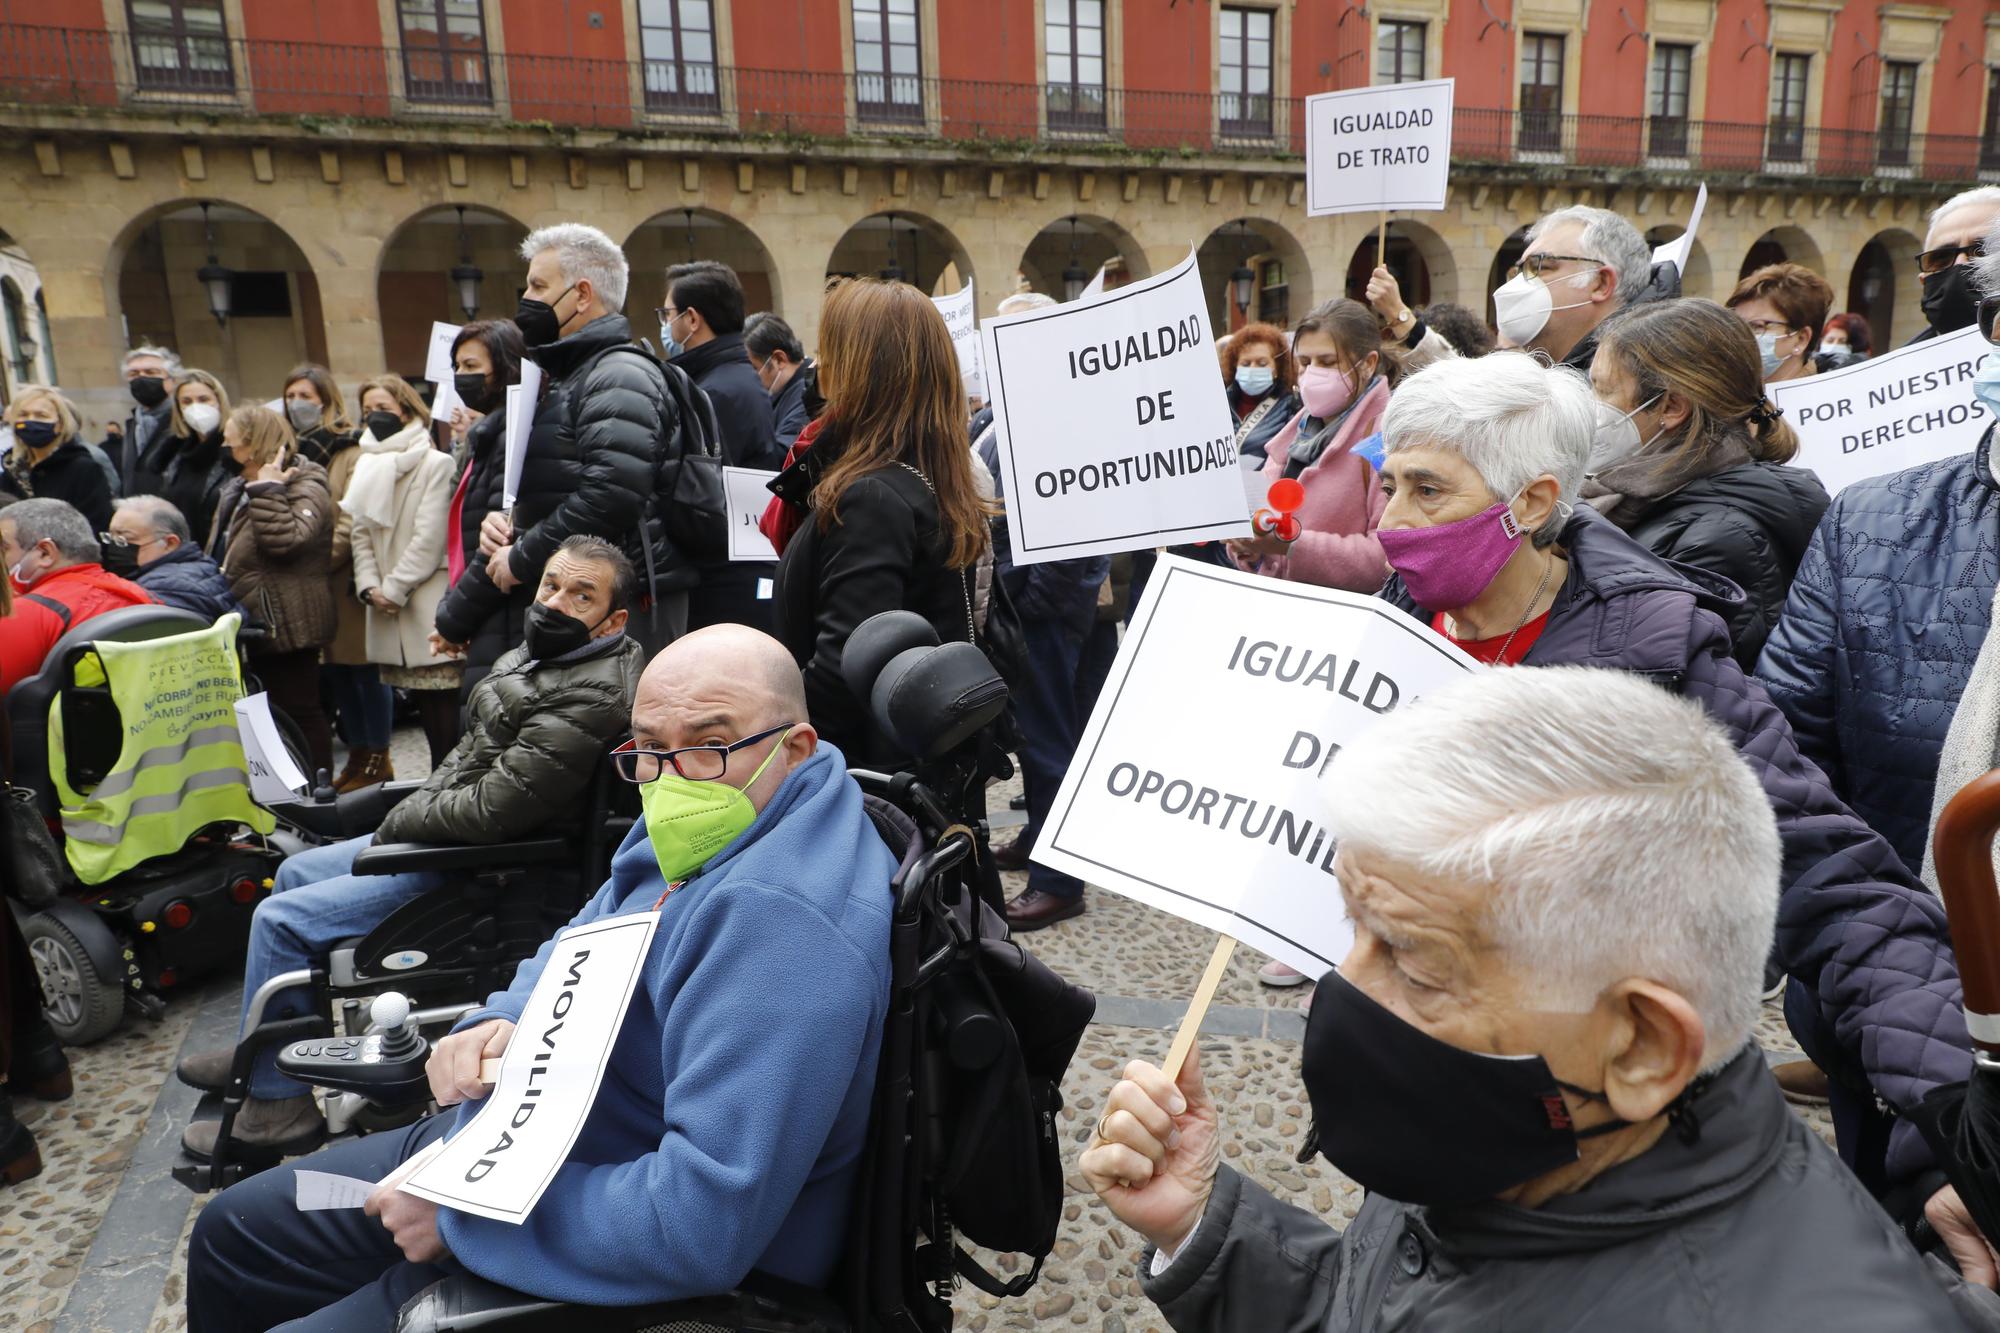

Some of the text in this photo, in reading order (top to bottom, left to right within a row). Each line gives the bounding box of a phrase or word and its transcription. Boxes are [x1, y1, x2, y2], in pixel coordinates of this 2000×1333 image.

[1333, 108, 1433, 135] IGUALDAD
[1337, 145, 1430, 170] DE TRATO
[1068, 313, 1201, 379] IGUALDAD
[1136, 390, 1175, 426] DE
[1799, 398, 1853, 426] POR
[1841, 399, 1986, 454] DERECHOS
[1034, 434, 1237, 499] OPORTUNIDADES
[1227, 635, 1401, 715] IGUALD
[464, 949, 591, 1183] MOVILIDAD
